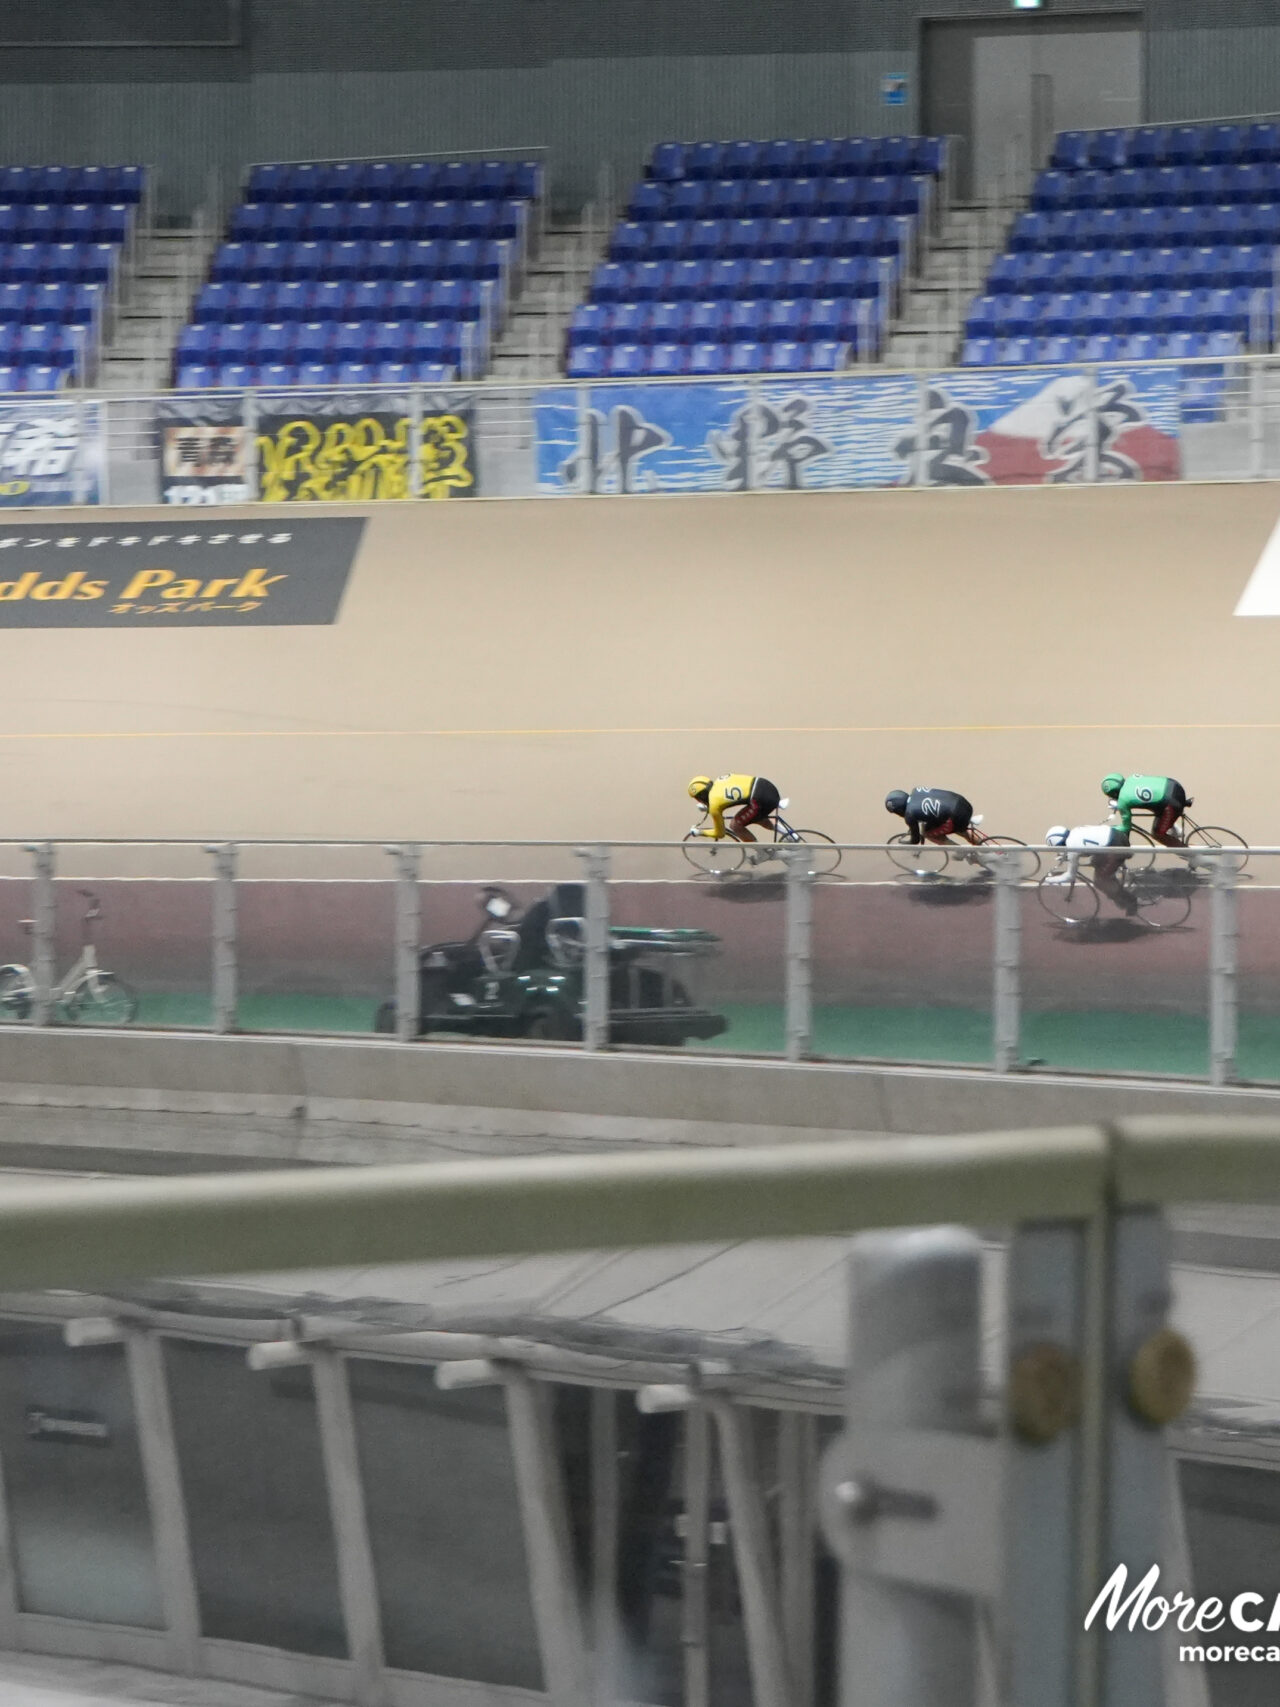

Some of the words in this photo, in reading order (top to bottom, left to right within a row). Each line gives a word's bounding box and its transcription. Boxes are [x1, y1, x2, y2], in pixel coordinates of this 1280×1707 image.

[119, 568, 289, 599] Park
[724, 785, 743, 801] 5
[1135, 787, 1153, 803] 6
[921, 797, 941, 818] 2
